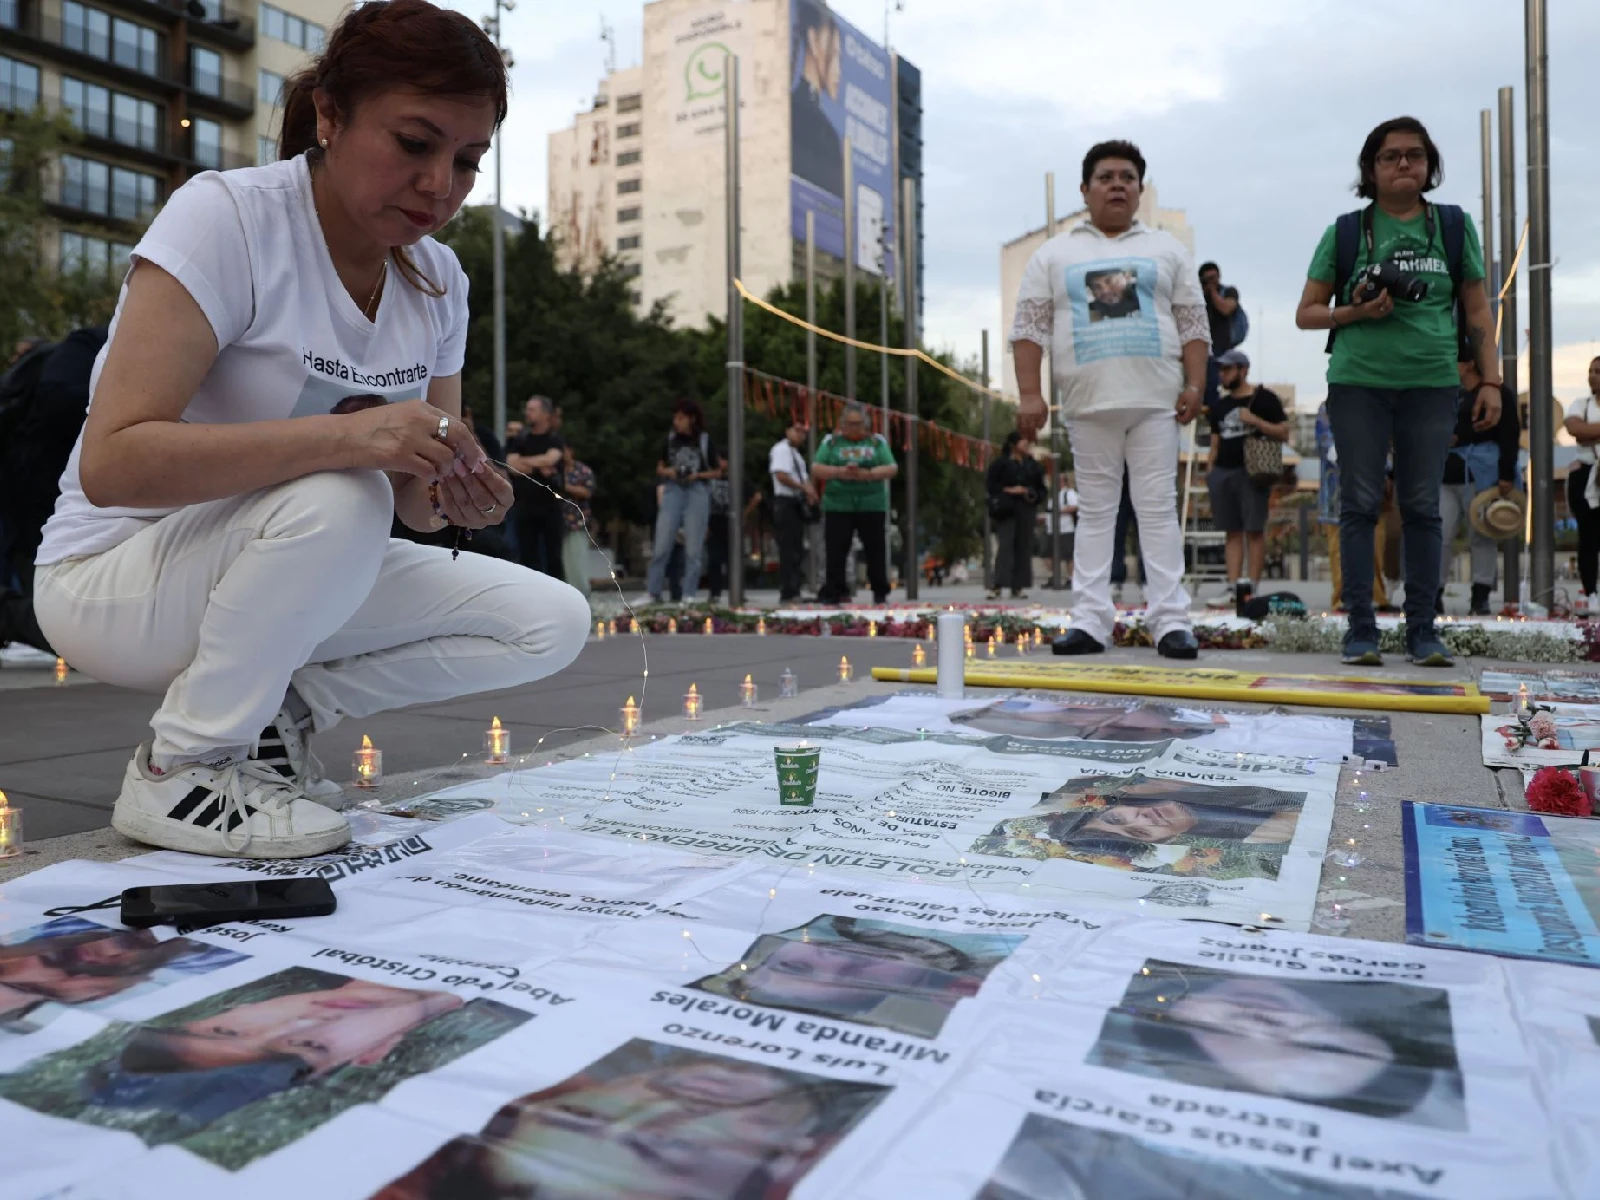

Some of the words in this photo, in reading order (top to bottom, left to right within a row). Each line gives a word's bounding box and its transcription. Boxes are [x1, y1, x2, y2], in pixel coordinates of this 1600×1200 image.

[303, 347, 349, 380] Hasta
[350, 363, 428, 388] Encontrarte
[936, 784, 956, 792] NO
[960, 786, 1011, 799] BIGOTE:
[889, 814, 958, 830] ESTATUR
[610, 828, 761, 854] URGENCIA
[762, 844, 810, 860] DE
[812, 853, 962, 878] BOLETÍN
[434, 879, 564, 910] información
[820, 888, 959, 914] Valenzuela
[564, 904, 641, 920] mayor
[853, 904, 957, 924] Alfonso
[310, 948, 436, 982] Cristóbal
[1196, 950, 1308, 970] Giselle
[1310, 951, 1426, 970] Garcés
[440, 974, 576, 1006] Abelrdo
[649, 990, 786, 1032] Morales
[661, 1022, 804, 1062] Lorenzo
[794, 1020, 950, 1064] Miranda
[810, 1053, 889, 1077] Luis
[1032, 1088, 1174, 1135] García
[1148, 1094, 1320, 1139] Estrada
[1190, 1124, 1316, 1168] Jesús
[1331, 1153, 1444, 1187] Axel
